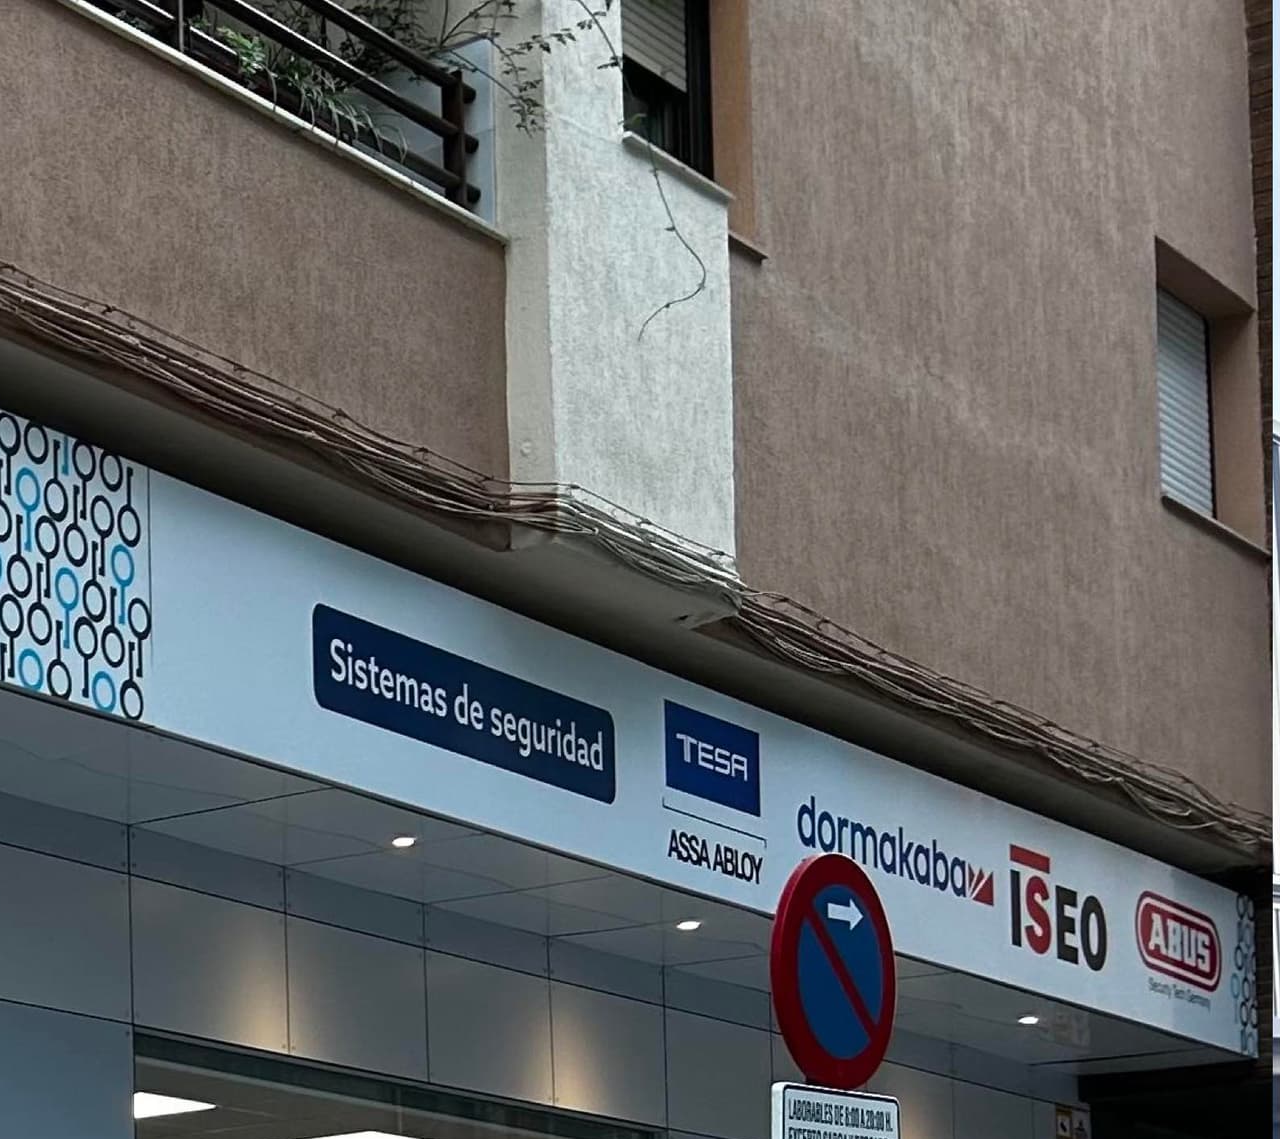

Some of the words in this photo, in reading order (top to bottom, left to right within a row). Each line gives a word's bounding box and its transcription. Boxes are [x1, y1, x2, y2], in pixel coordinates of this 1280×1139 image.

[330, 638, 447, 717] Sistemas
[454, 683, 484, 730] de
[490, 708, 603, 771] seguridad
[676, 733, 748, 781] TESA
[668, 829, 711, 869] ASSA
[713, 843, 763, 885] ABLOY
[797, 796, 967, 898] dormakaba
[1010, 844, 1107, 971] ISEO
[1149, 912, 1211, 974] ABUS
[788, 1099, 833, 1125] LABORABLES
[834, 1105, 844, 1126] DE
